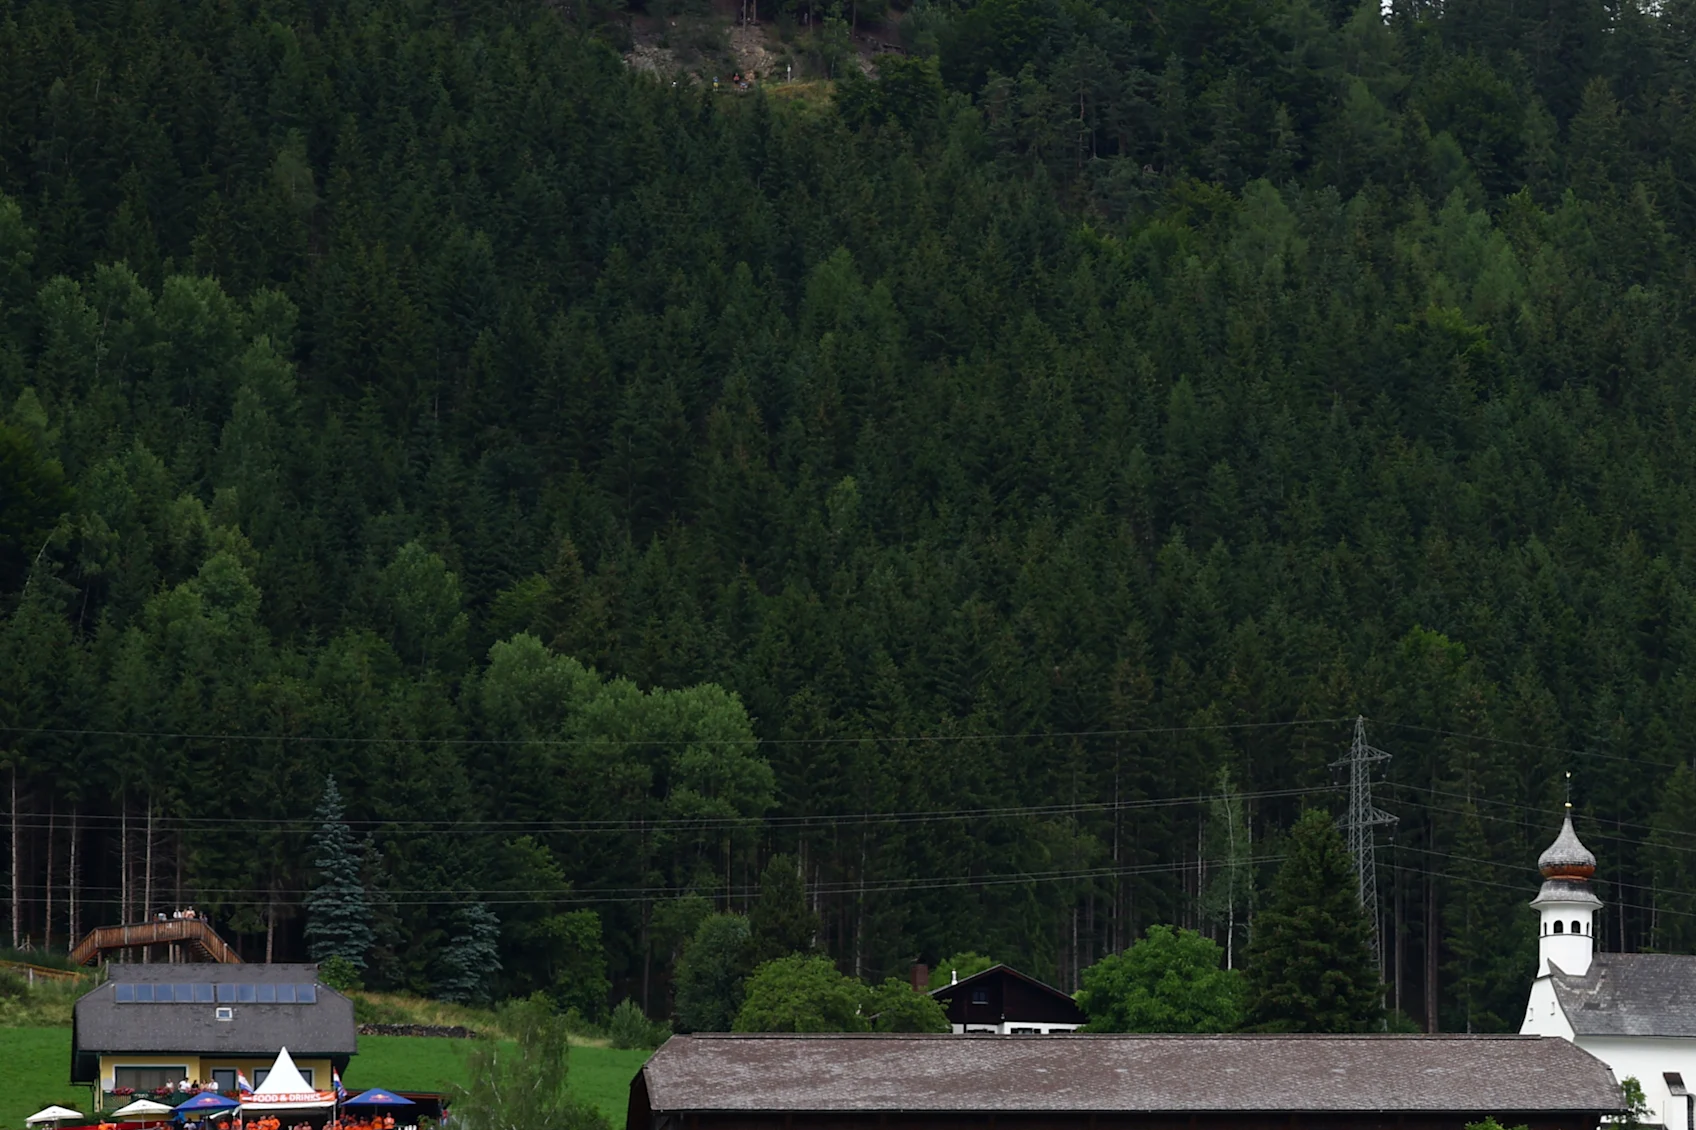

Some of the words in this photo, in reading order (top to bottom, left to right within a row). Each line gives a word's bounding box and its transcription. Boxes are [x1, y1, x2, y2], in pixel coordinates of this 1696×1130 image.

[253, 1094, 278, 1102] FOOD
[279, 1094, 288, 1102] &
[289, 1093, 321, 1102] DRINKS
